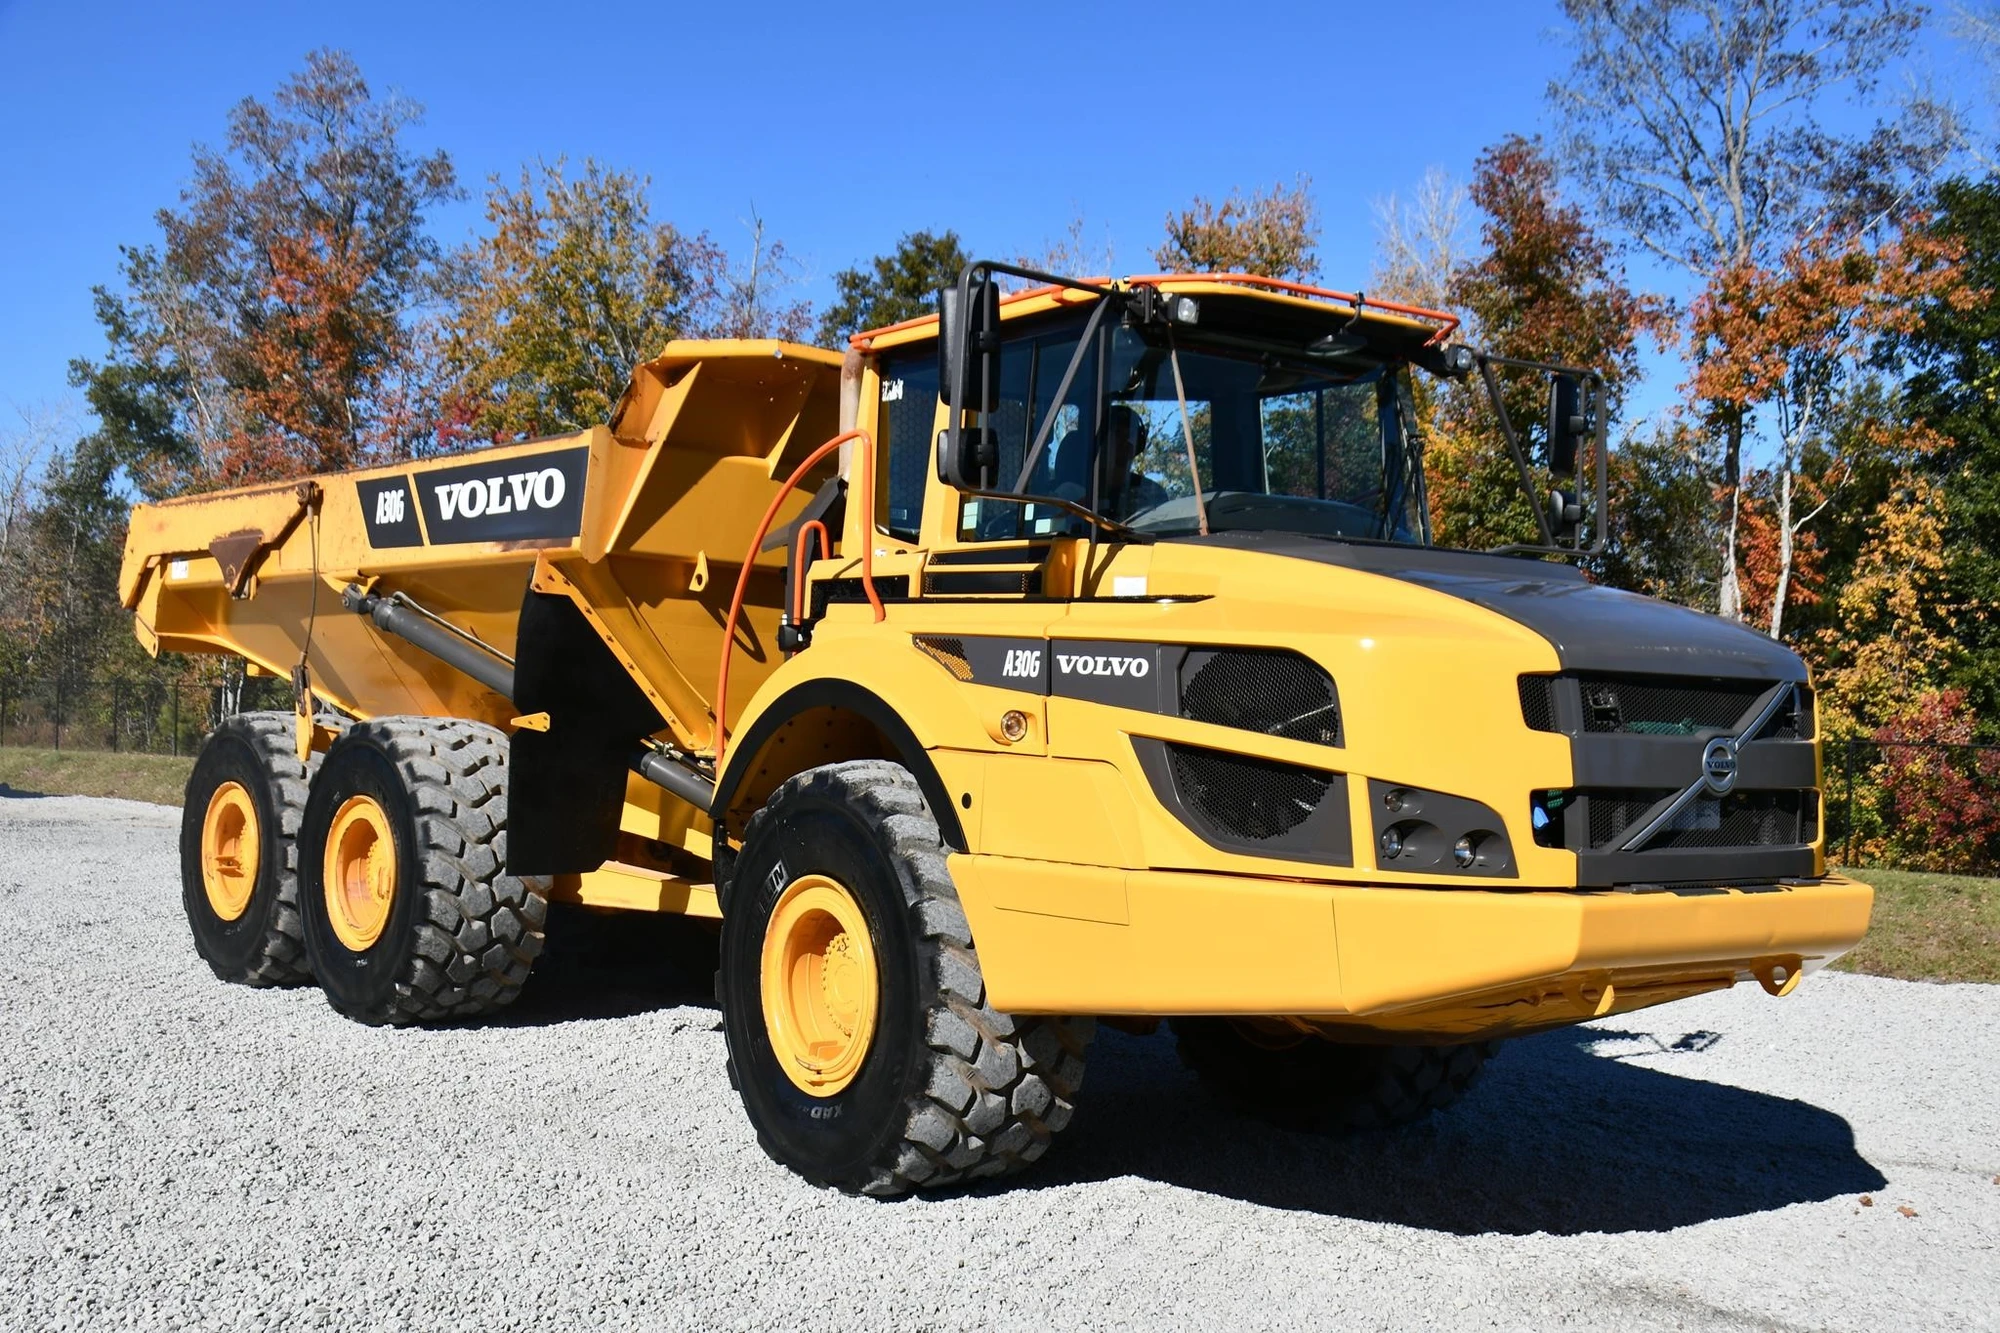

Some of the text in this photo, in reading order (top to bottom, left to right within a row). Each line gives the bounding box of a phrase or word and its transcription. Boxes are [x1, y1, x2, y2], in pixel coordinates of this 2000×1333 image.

[434, 467, 566, 521] VOLVO
[1002, 649, 1041, 678] A30G
[1056, 654, 1150, 678] VOLVO
[1706, 761, 1736, 769] VOLVO
